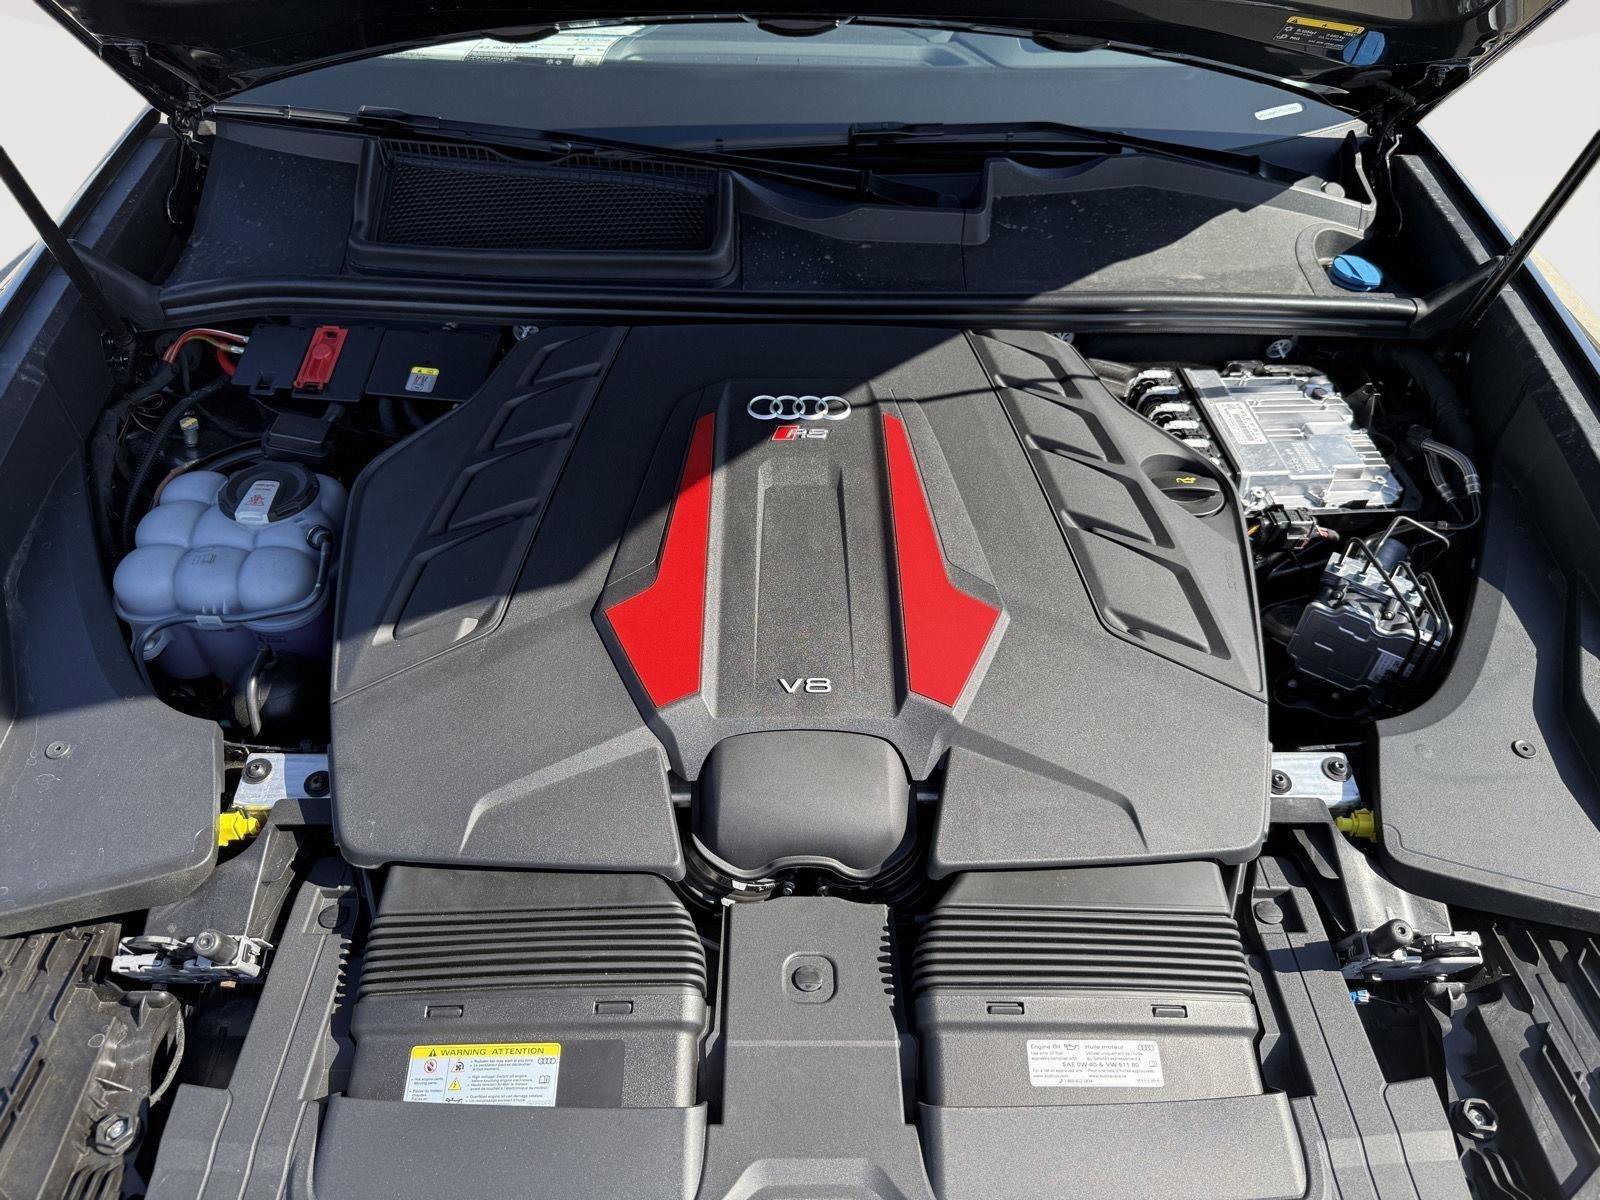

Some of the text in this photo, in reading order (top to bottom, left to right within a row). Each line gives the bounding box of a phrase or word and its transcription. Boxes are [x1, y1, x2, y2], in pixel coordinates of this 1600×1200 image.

[785, 427, 829, 439] RS
[779, 678, 832, 693] V8
[440, 1047, 545, 1056] WARNING ATTENTION
[1030, 1043, 1050, 1051] Engine
